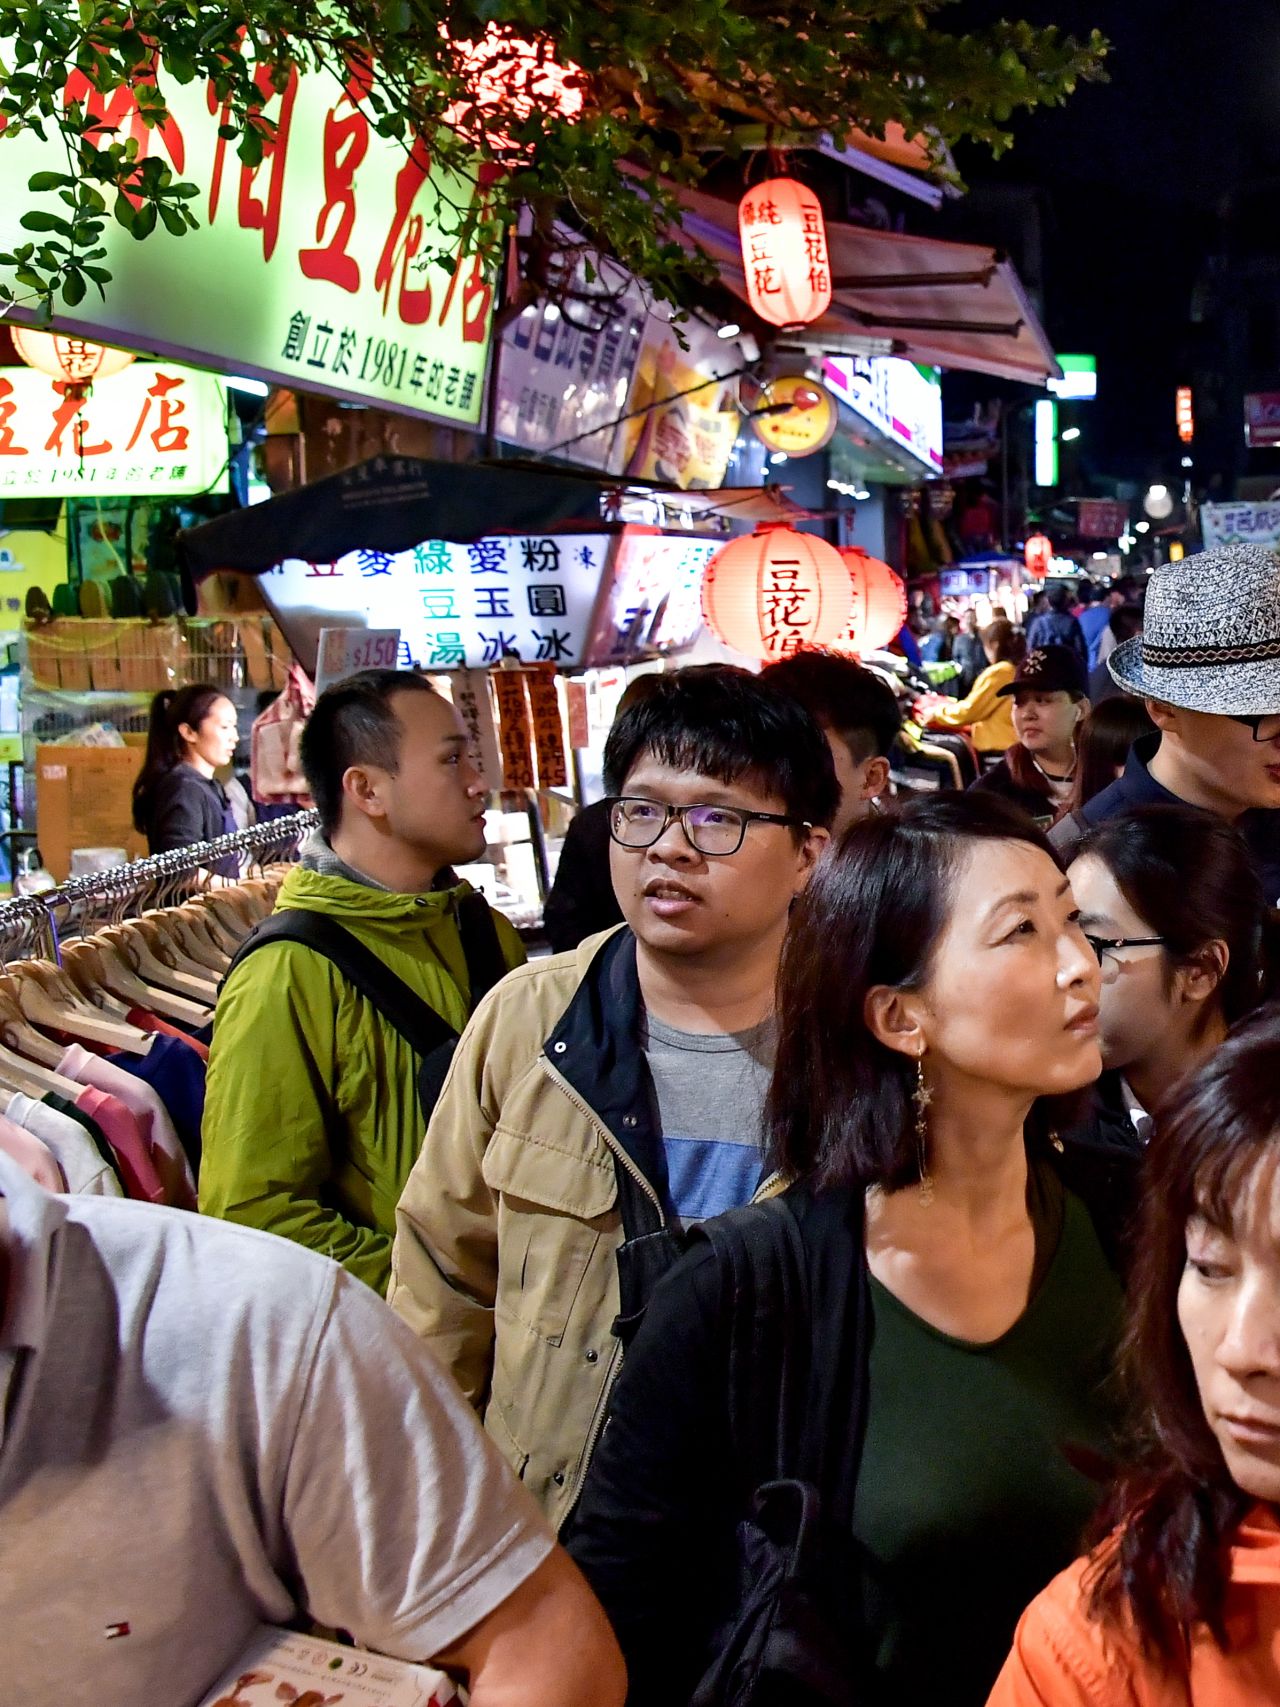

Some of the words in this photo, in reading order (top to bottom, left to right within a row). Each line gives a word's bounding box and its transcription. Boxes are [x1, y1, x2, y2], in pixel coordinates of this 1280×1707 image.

[413, 540, 466, 665] 綠豆湯
[467, 540, 519, 662] 愛玉冰
[521, 538, 574, 661] 粉圓冰
[762, 559, 811, 653] 豆花伯
